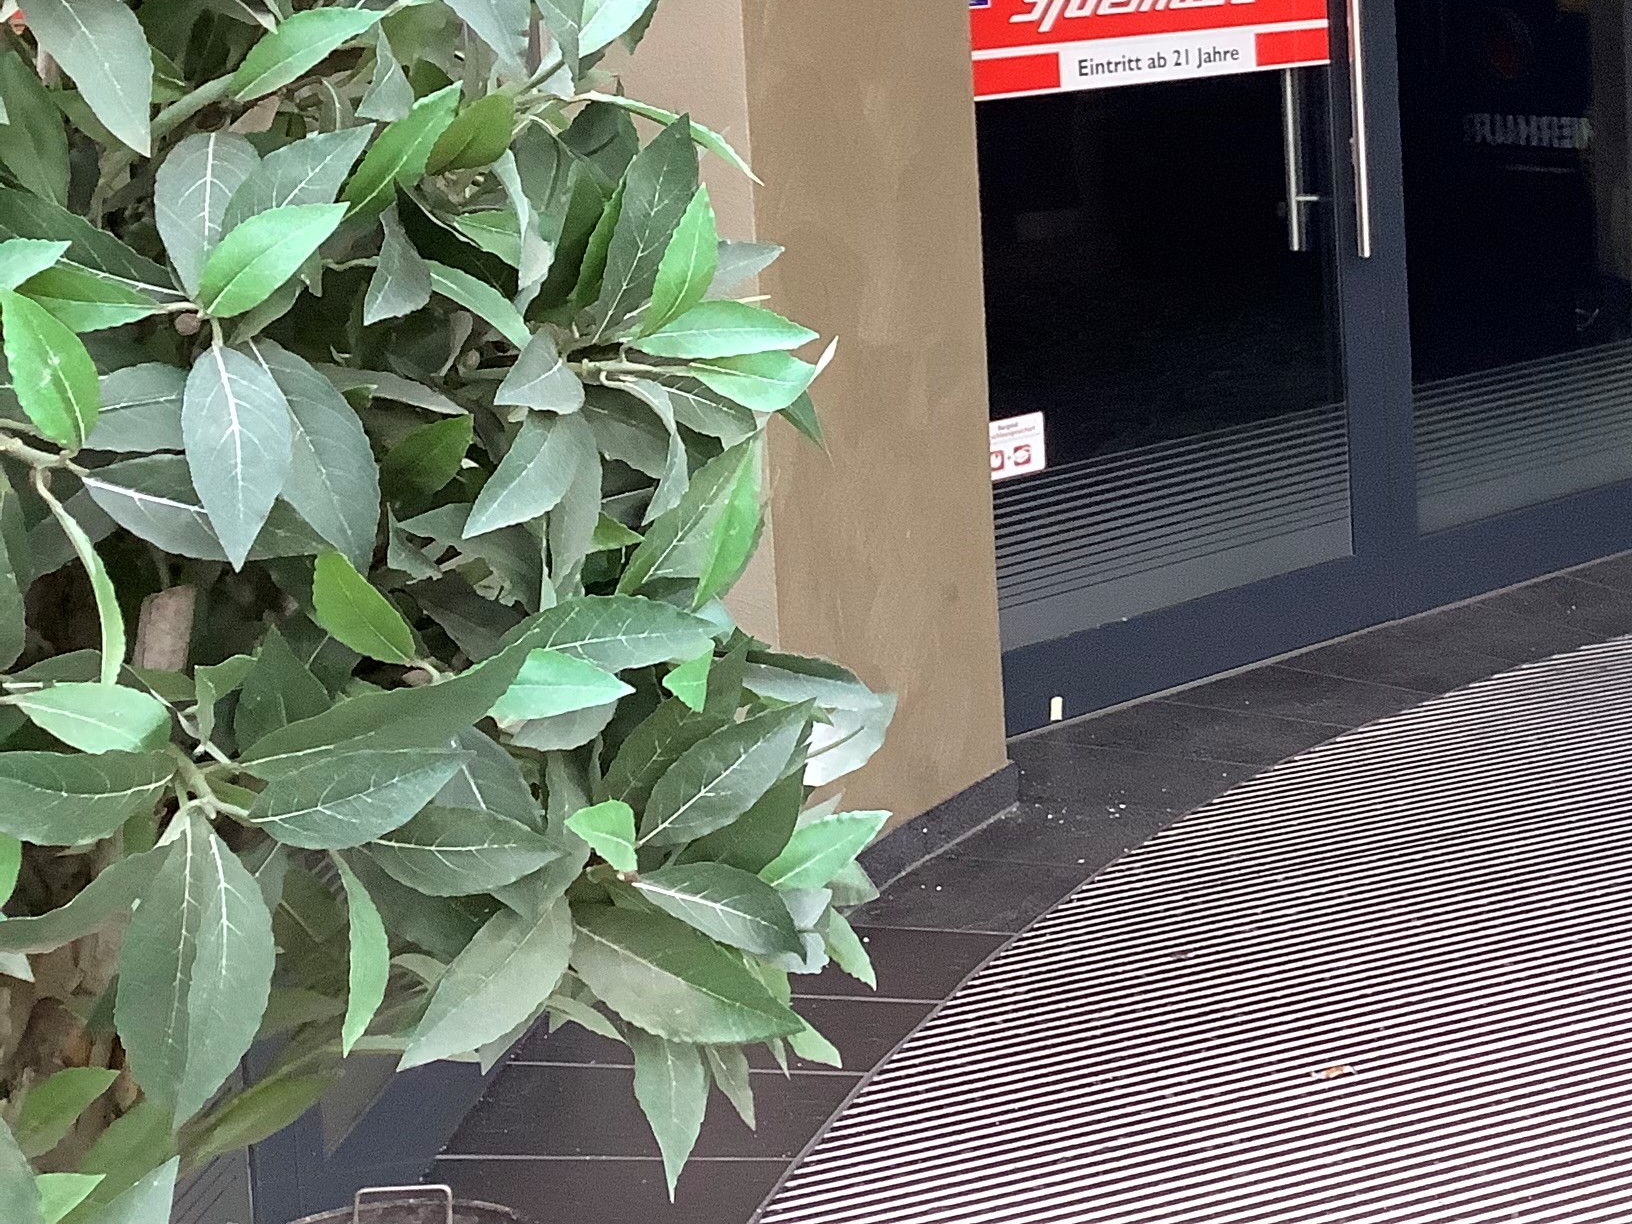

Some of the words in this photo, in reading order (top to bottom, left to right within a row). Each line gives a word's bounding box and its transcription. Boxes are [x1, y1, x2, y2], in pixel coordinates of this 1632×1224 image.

[1078, 54, 1143, 77] Eintritt
[1147, 51, 1168, 70] ab
[1172, 48, 1190, 67] 21
[1196, 45, 1240, 69] Jahre
